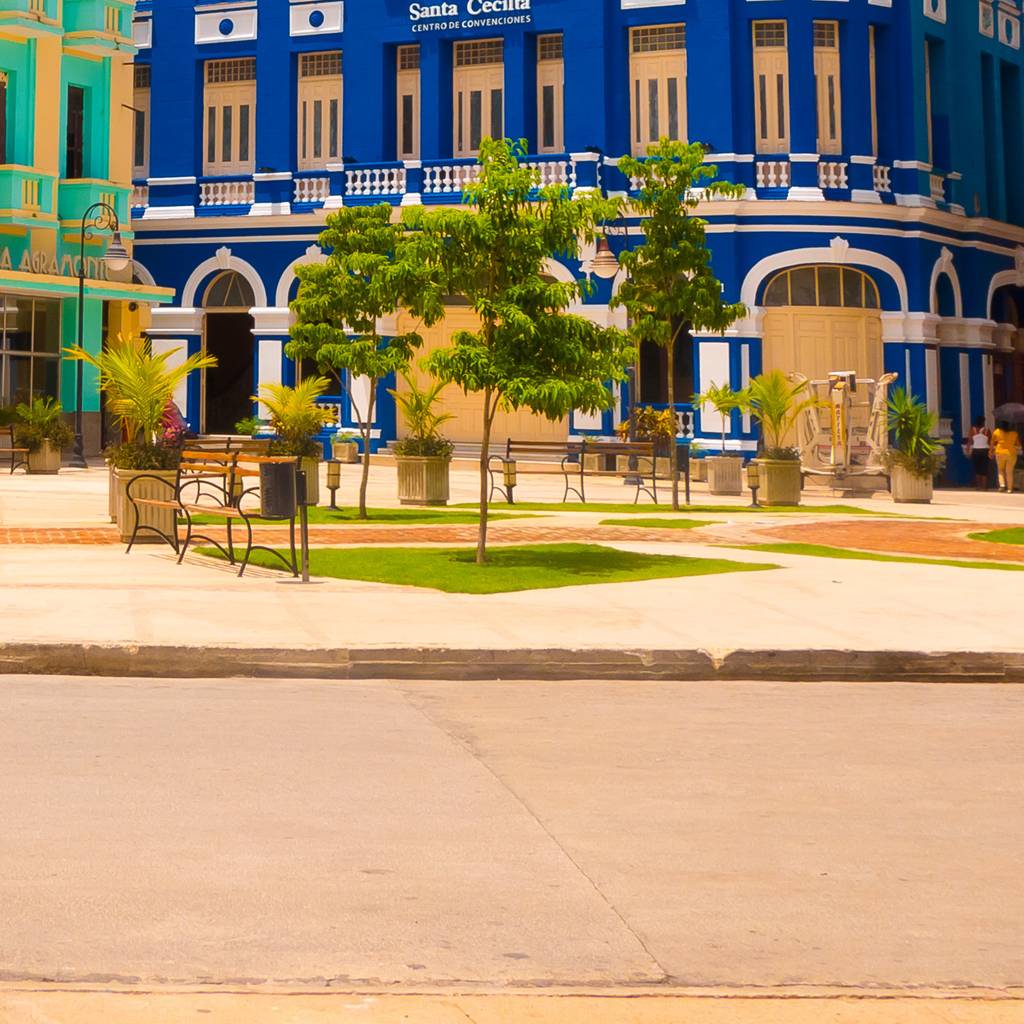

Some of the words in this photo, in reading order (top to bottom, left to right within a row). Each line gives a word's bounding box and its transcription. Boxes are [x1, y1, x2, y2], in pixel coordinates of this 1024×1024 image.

[409, 2, 458, 21] Santa
[412, 22, 447, 32] CENTRO
[449, 21, 460, 29] DE
[462, 15, 531, 28] CONVENCIONES
